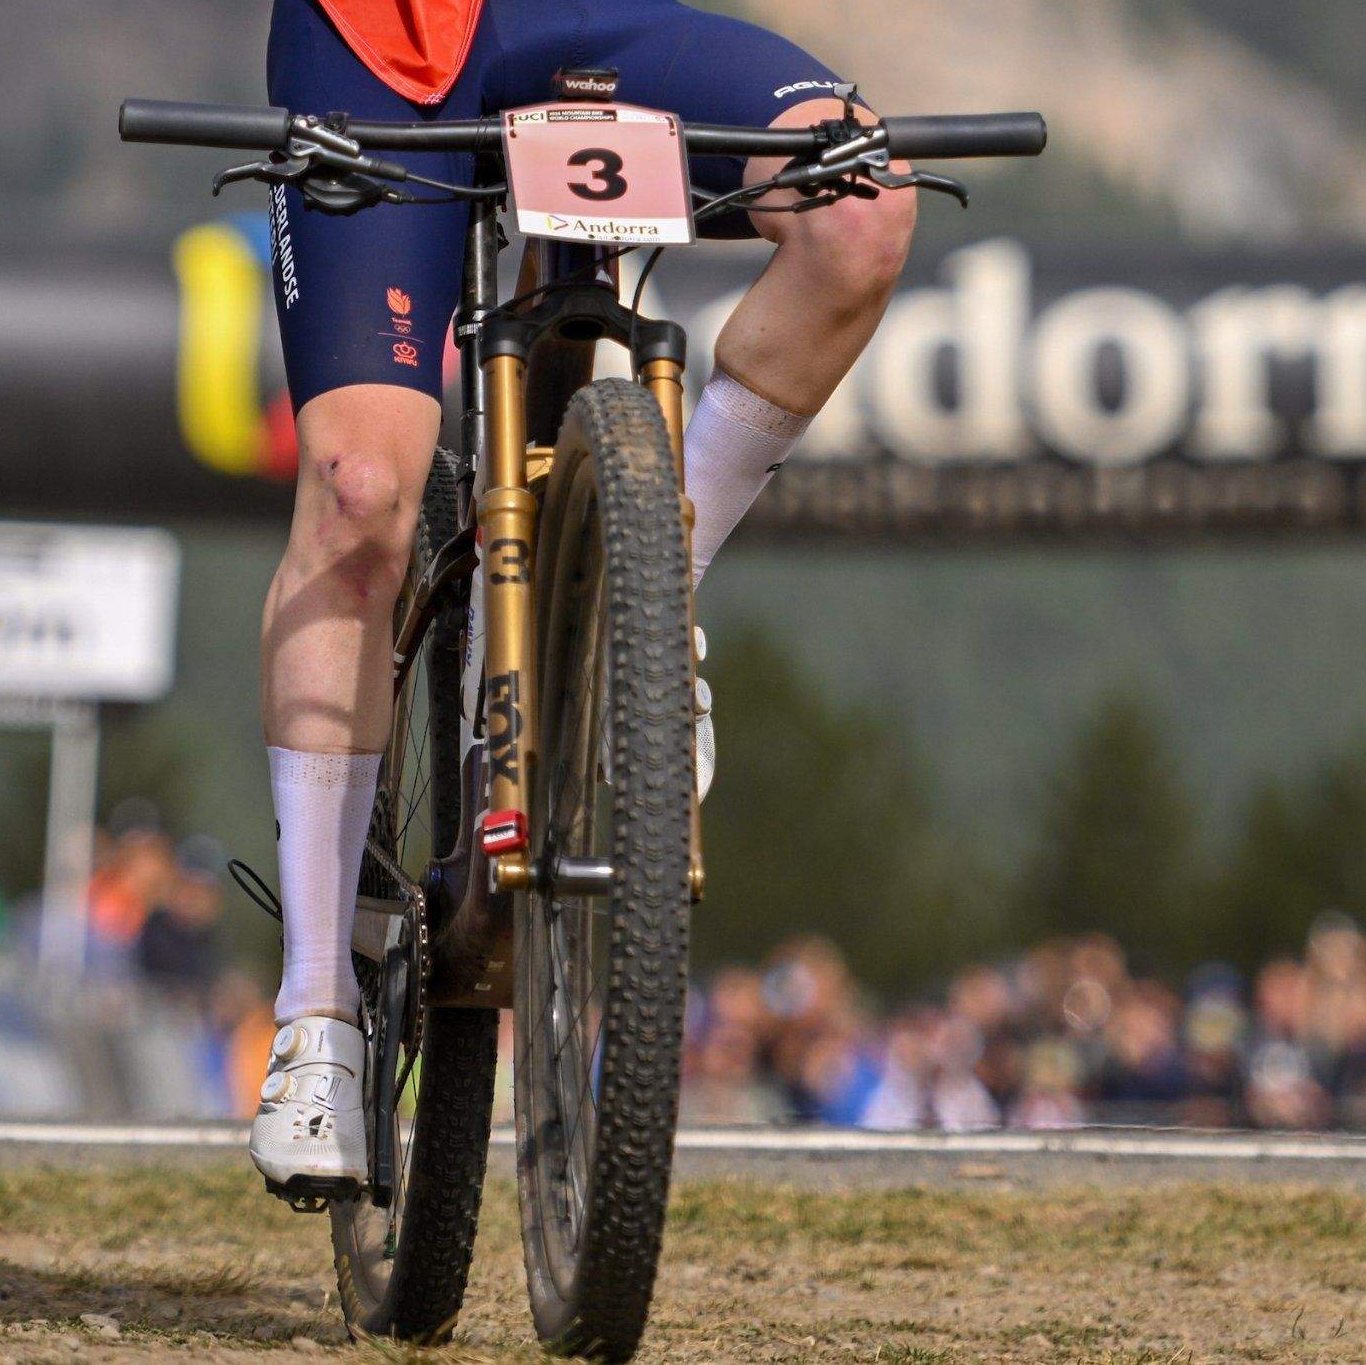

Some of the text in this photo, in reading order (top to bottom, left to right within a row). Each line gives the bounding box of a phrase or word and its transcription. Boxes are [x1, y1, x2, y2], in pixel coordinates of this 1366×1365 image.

[565, 78, 616, 92] wahoo
[518, 113, 544, 122] UCI
[566, 147, 628, 202] 3
[572, 219, 659, 236] Andorra
[485, 670, 524, 786] FOX
